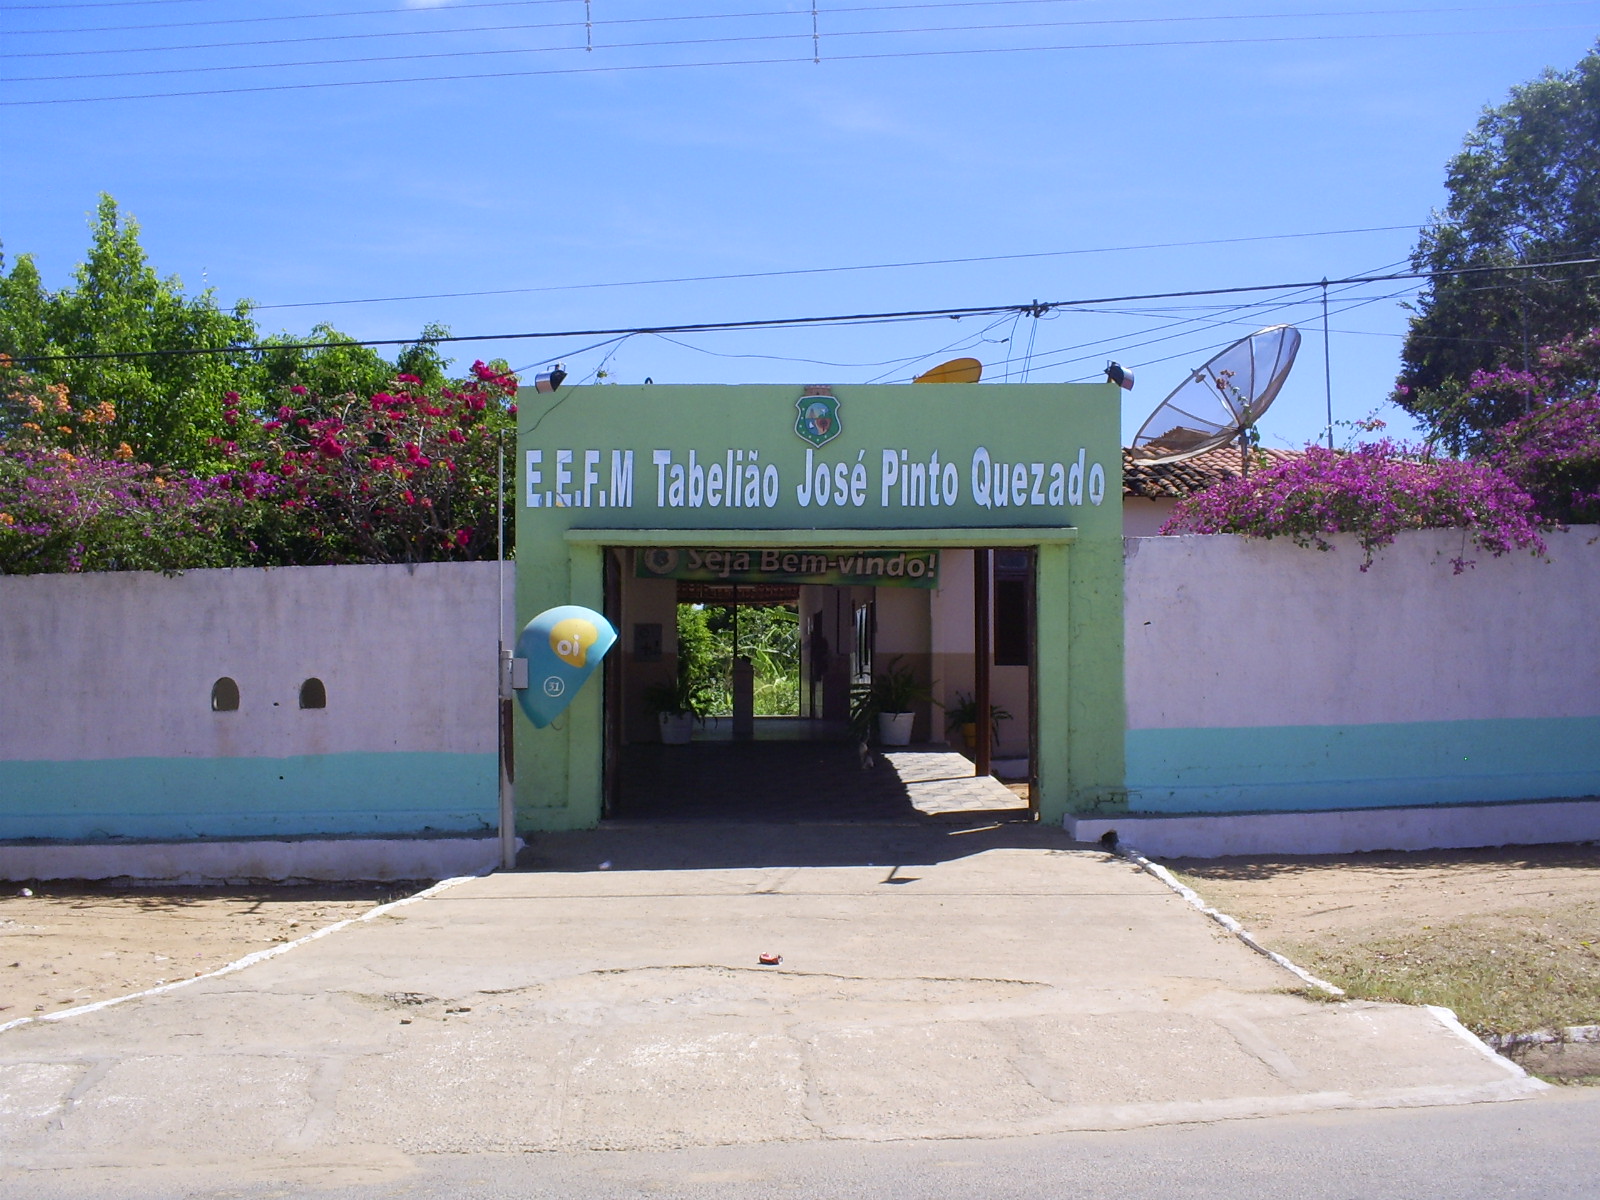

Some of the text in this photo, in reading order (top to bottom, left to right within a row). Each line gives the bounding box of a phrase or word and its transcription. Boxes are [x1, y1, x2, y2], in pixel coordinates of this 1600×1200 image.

[525, 446, 1106, 510] E.E.F.M Tabelião José Pinto Quezado
[688, 550, 937, 578] Seja Bem-vindo!
[557, 633, 580, 657] oi
